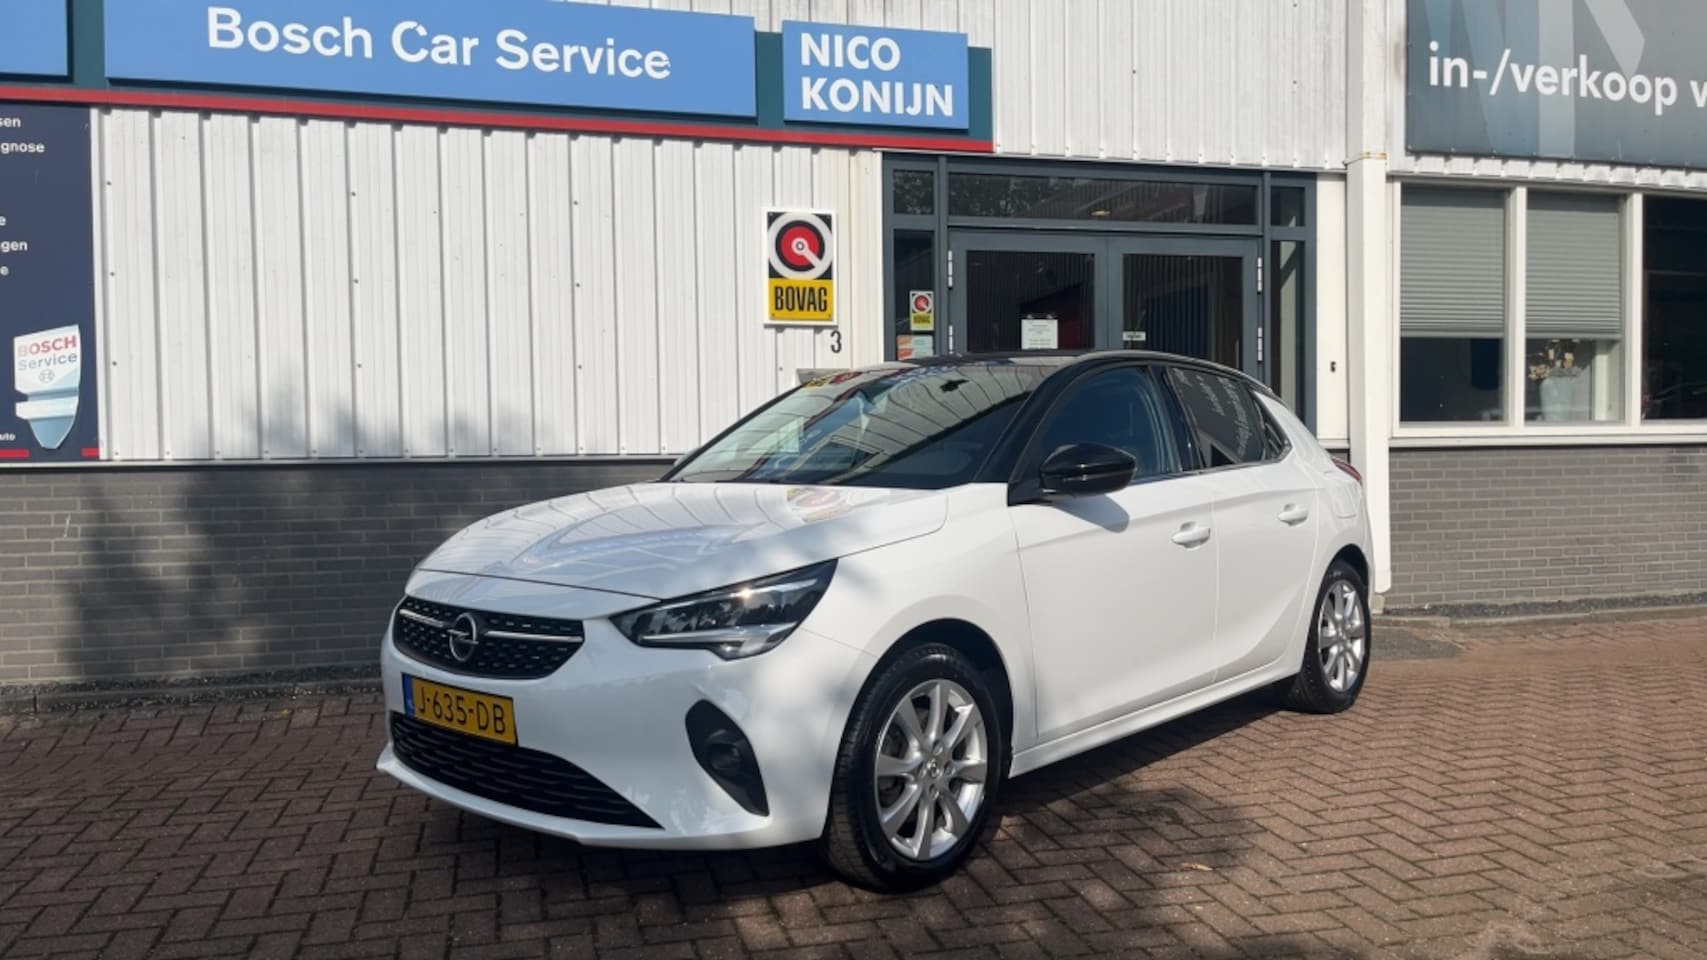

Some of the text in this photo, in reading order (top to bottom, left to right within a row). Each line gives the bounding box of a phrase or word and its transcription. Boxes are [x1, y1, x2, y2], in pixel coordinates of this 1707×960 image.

[206, 5, 672, 80] Bosch Car Service
[800, 32, 901, 72] NICO
[801, 76, 954, 117] KONIJN
[1429, 40, 1678, 116] in-/verkoop
[774, 285, 828, 312] BOVAG
[17, 334, 77, 358] BOSCH
[17, 352, 78, 371] Service
[830, 330, 843, 354] 3
[419, 686, 506, 734] J-635-DB
